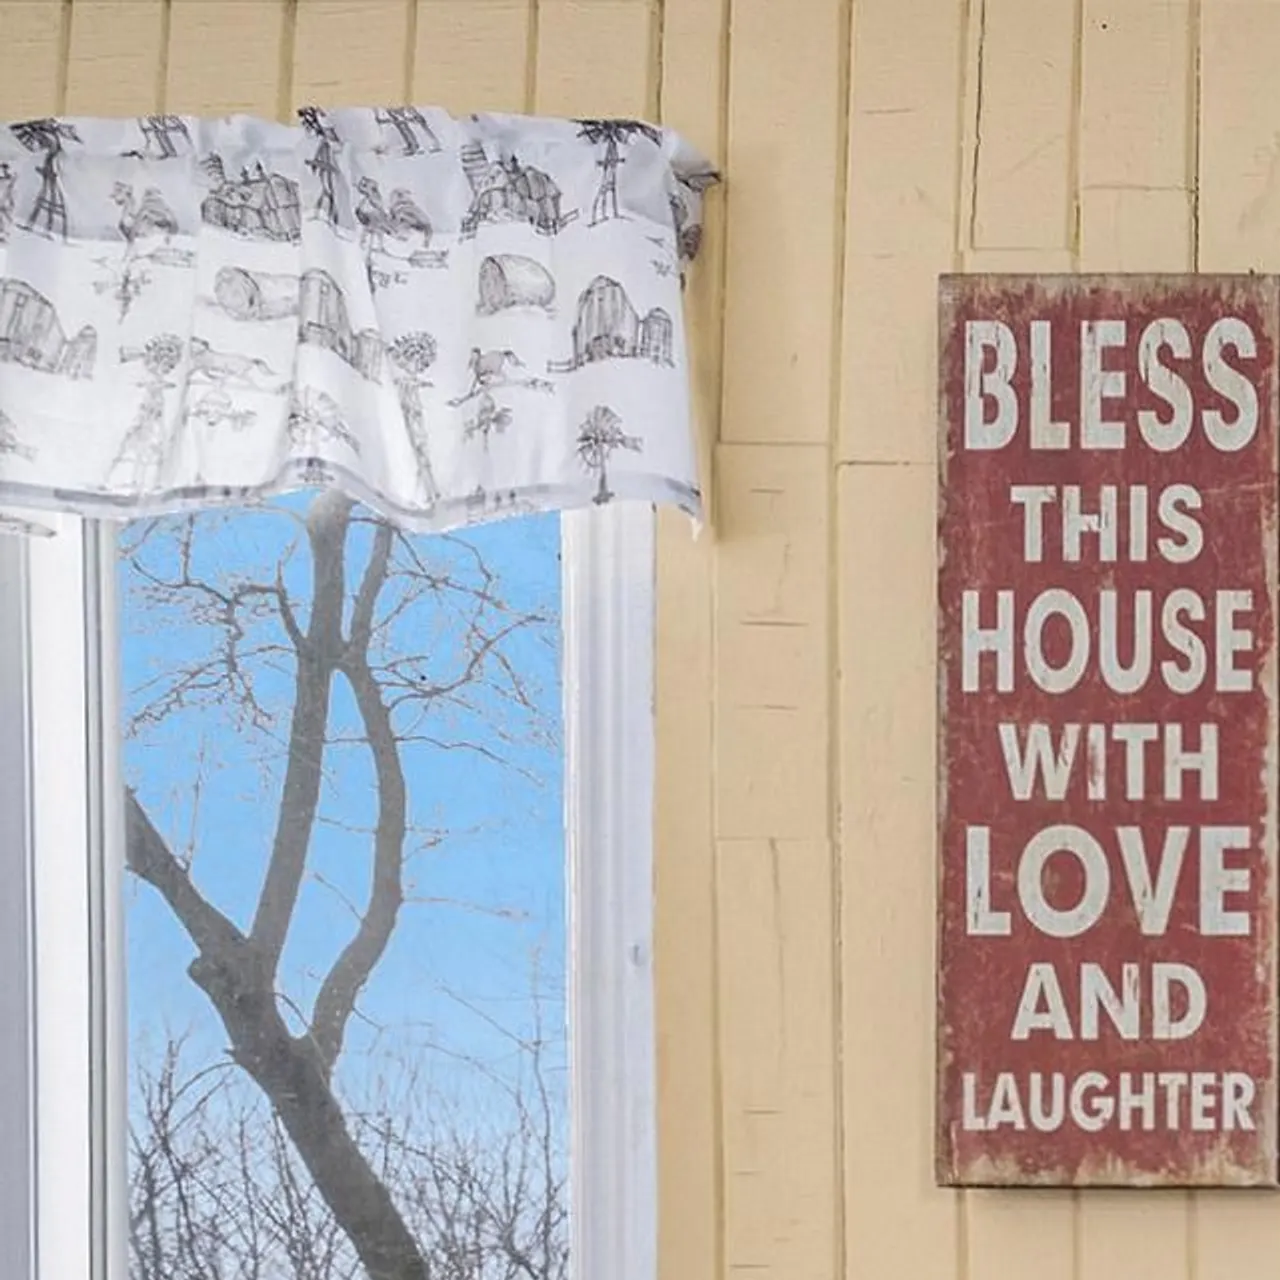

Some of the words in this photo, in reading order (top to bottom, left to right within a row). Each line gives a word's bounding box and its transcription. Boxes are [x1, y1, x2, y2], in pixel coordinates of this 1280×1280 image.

[963, 317, 1260, 453] BLESS
[1010, 484, 1204, 564] THIS
[961, 588, 1255, 694] HOUSE
[998, 723, 1219, 801] WITH
[965, 823, 1252, 938] LOVE
[1010, 962, 1208, 1041] AND
[962, 1070, 1256, 1132] LAUGHTER
